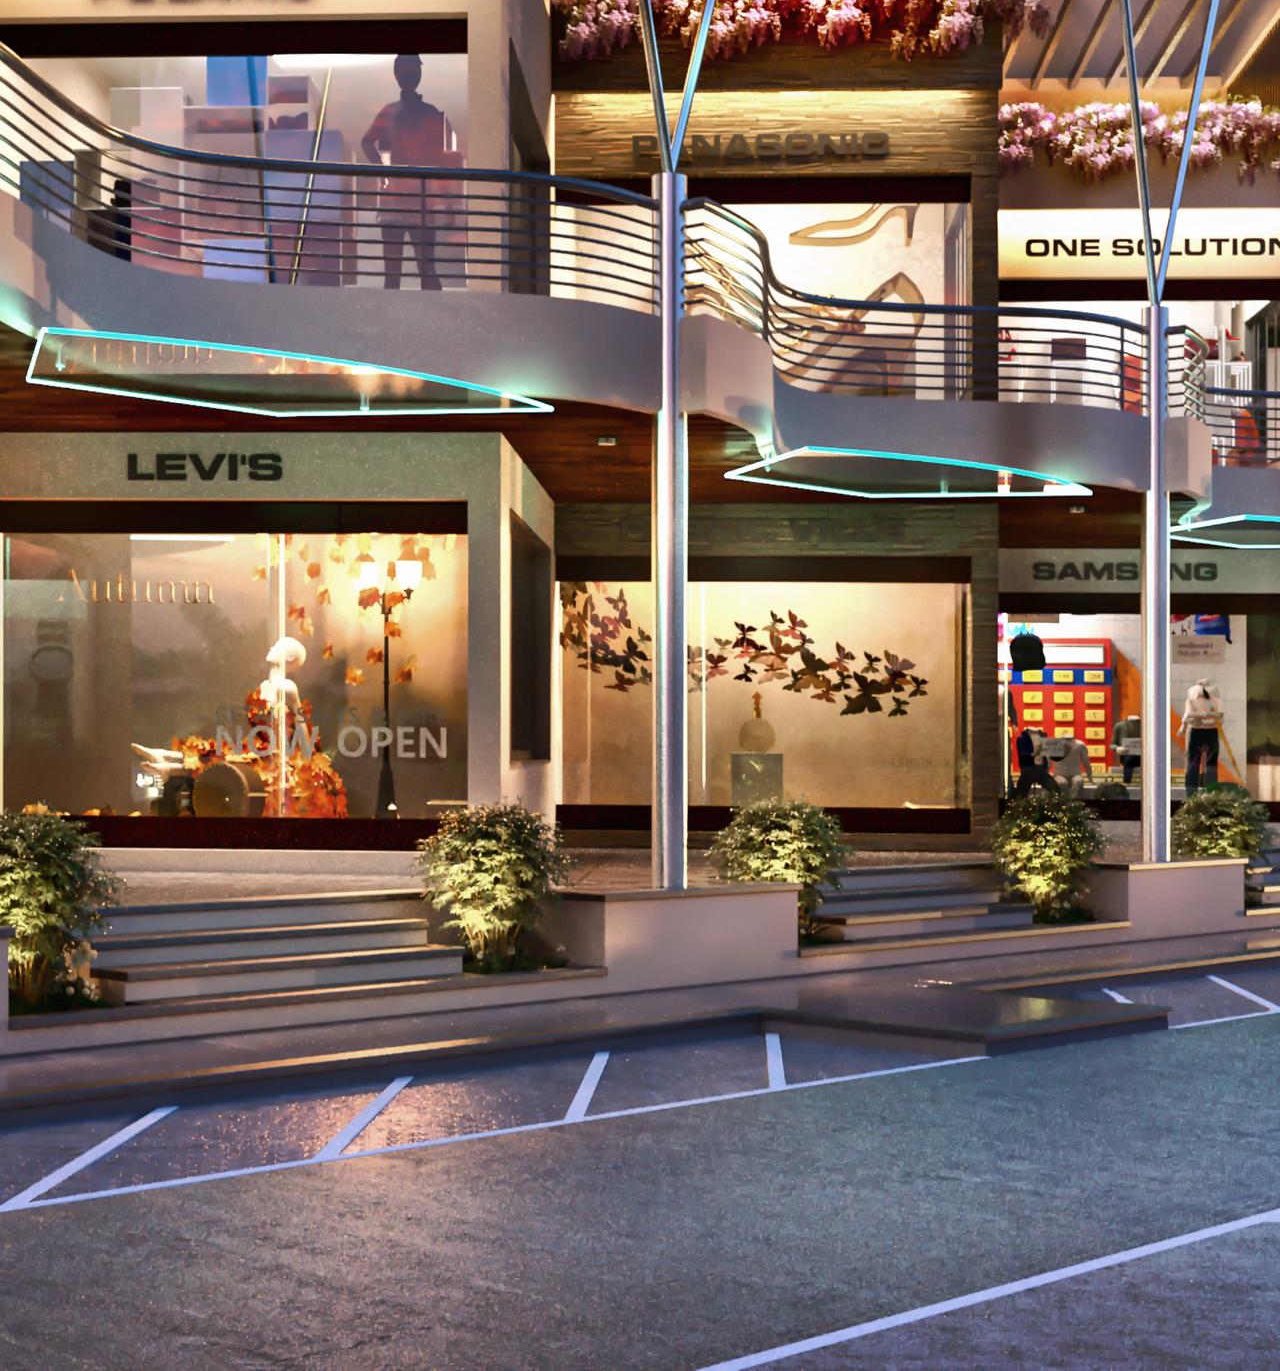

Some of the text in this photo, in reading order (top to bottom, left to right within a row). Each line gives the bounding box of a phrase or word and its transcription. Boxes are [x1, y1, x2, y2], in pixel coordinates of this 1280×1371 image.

[1025, 238, 1101, 257] ONE
[126, 452, 283, 482] LEVI'S
[56, 568, 216, 603] Autumn
[1032, 561, 1218, 581] SAMSNG
[215, 724, 448, 759] NOW OPEN
